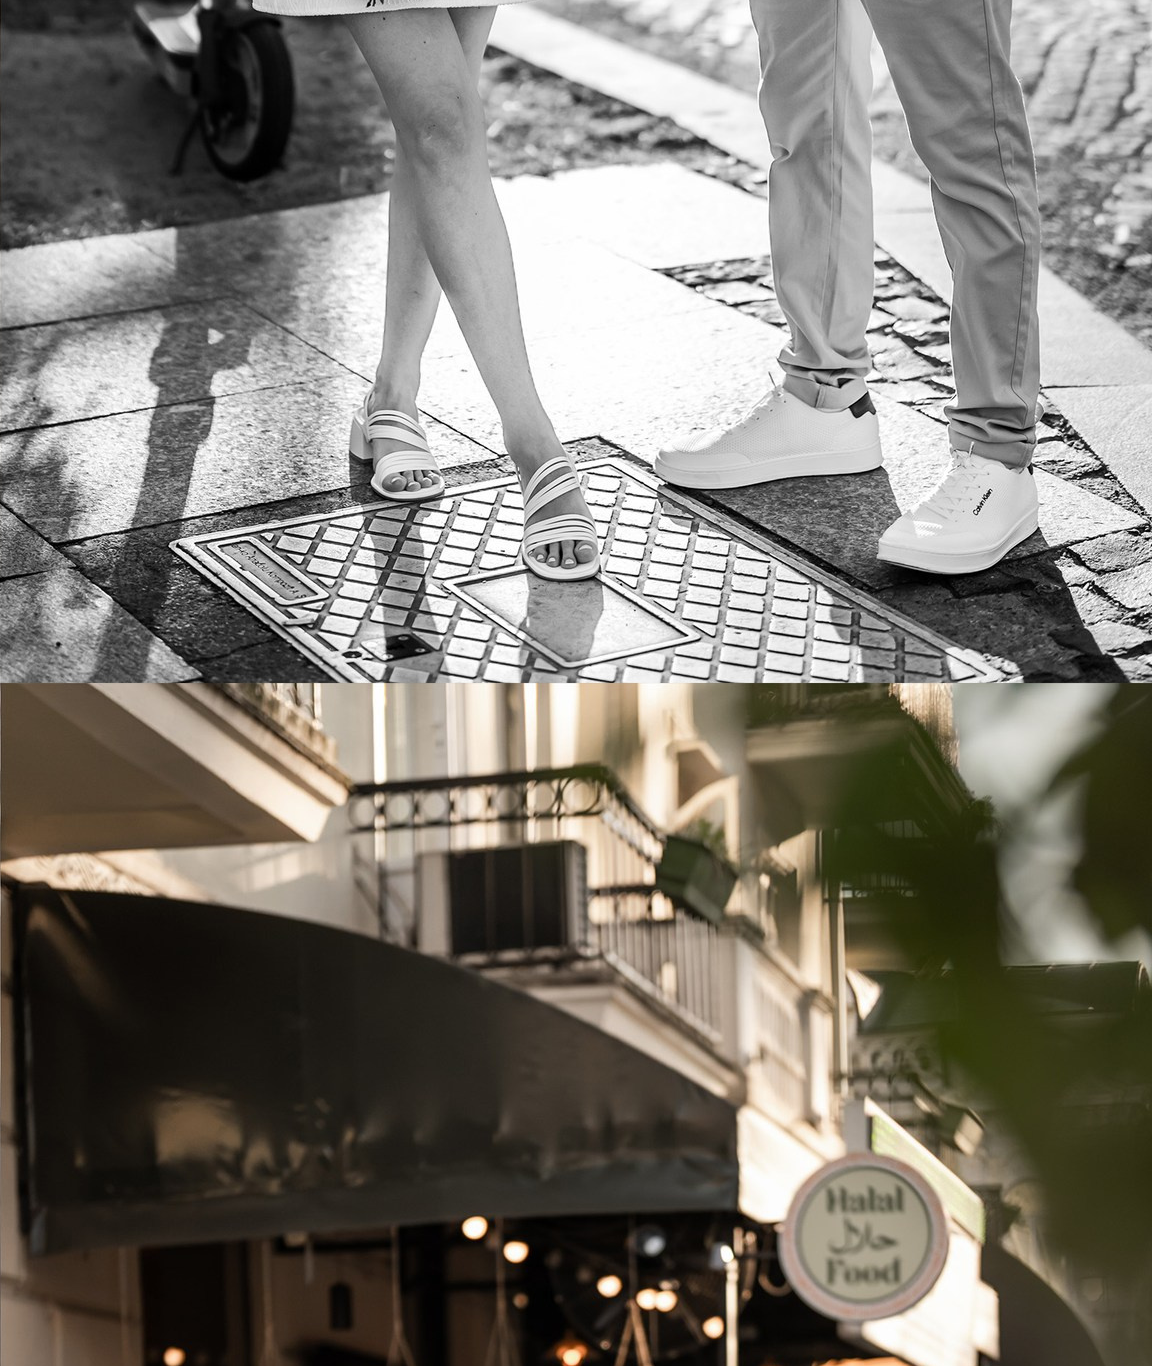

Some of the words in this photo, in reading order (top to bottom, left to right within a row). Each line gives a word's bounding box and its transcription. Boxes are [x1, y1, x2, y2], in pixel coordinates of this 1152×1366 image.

[972, 500, 985, 515] Calvin
[982, 488, 993, 501] Klein
[827, 1183, 903, 1213] Halal
[827, 1217, 898, 1254] حلال
[827, 1256, 900, 1284] Food
